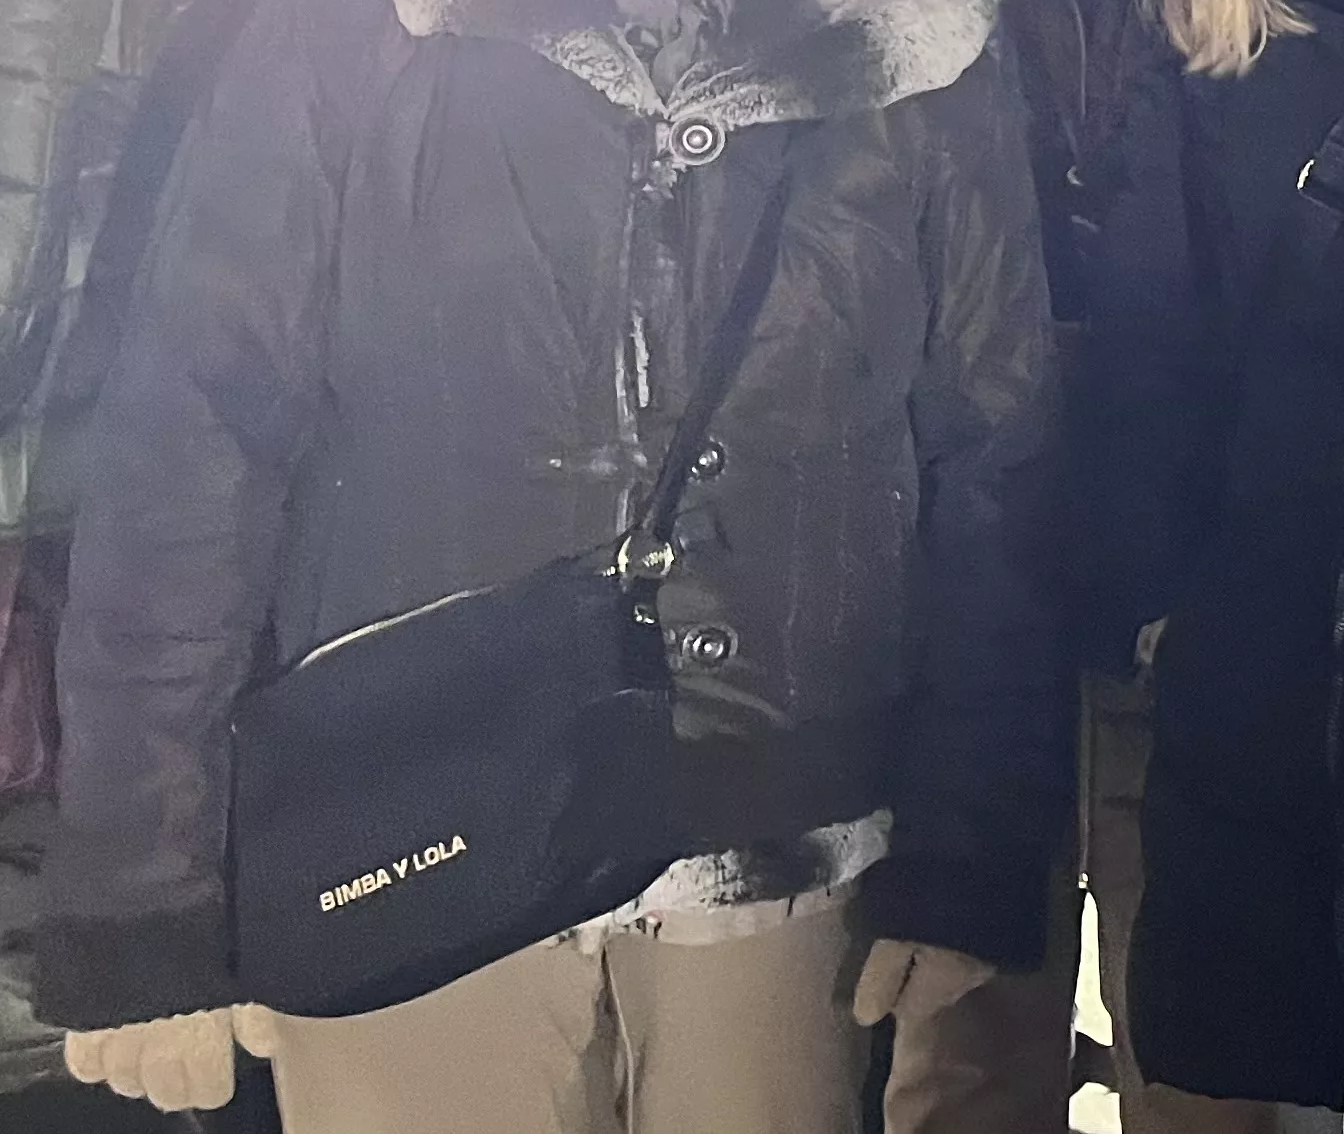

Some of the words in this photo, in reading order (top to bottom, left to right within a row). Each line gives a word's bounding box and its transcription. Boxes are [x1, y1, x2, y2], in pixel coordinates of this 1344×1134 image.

[319, 868, 392, 911] BIMBA
[392, 857, 408, 878] Y
[412, 835, 466, 871] LOLA
